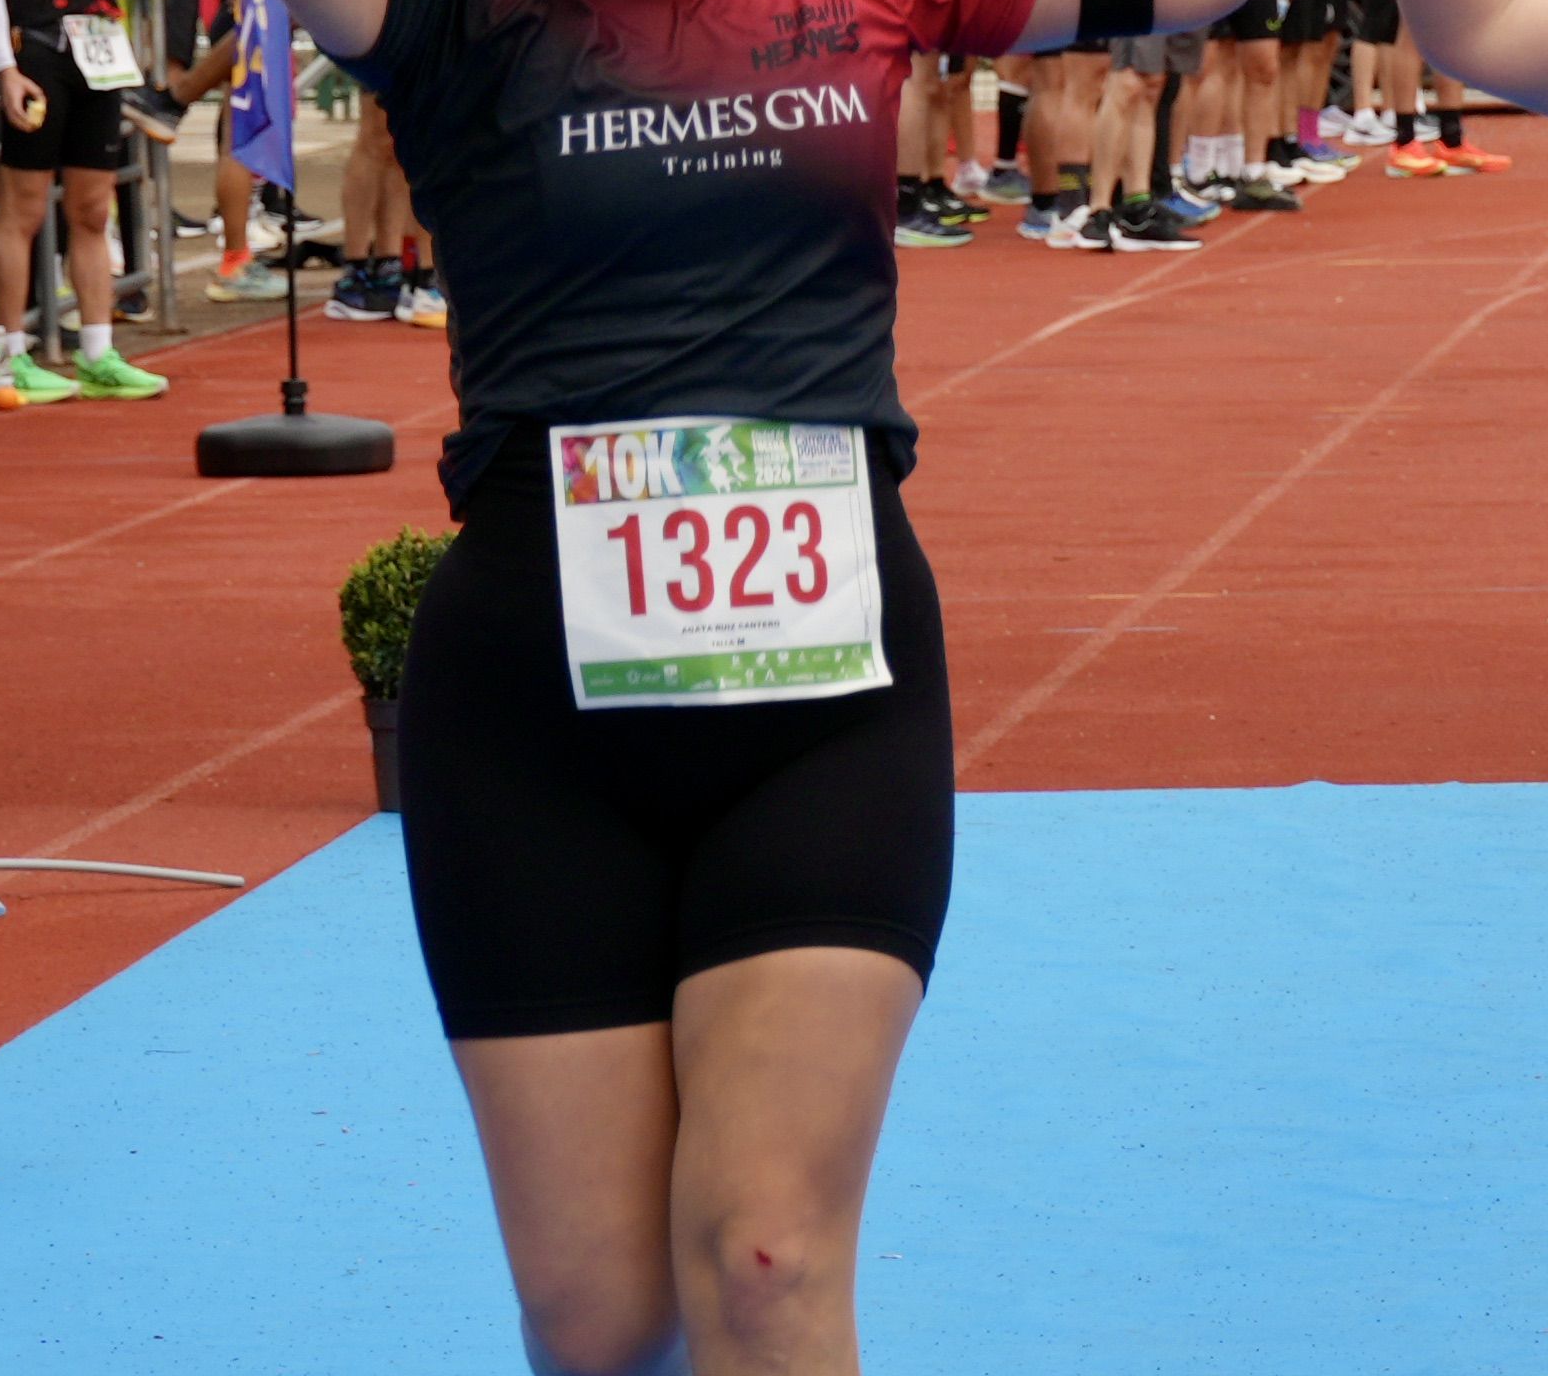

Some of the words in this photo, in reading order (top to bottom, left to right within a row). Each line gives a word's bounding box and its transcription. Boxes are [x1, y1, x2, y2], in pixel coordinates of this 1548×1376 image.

[751, 21, 861, 71] HERMES
[559, 93, 757, 157] HERMES
[764, 83, 870, 132] GYM
[662, 147, 783, 176] Training
[584, 430, 684, 502] 10K
[606, 499, 829, 617] 1323
